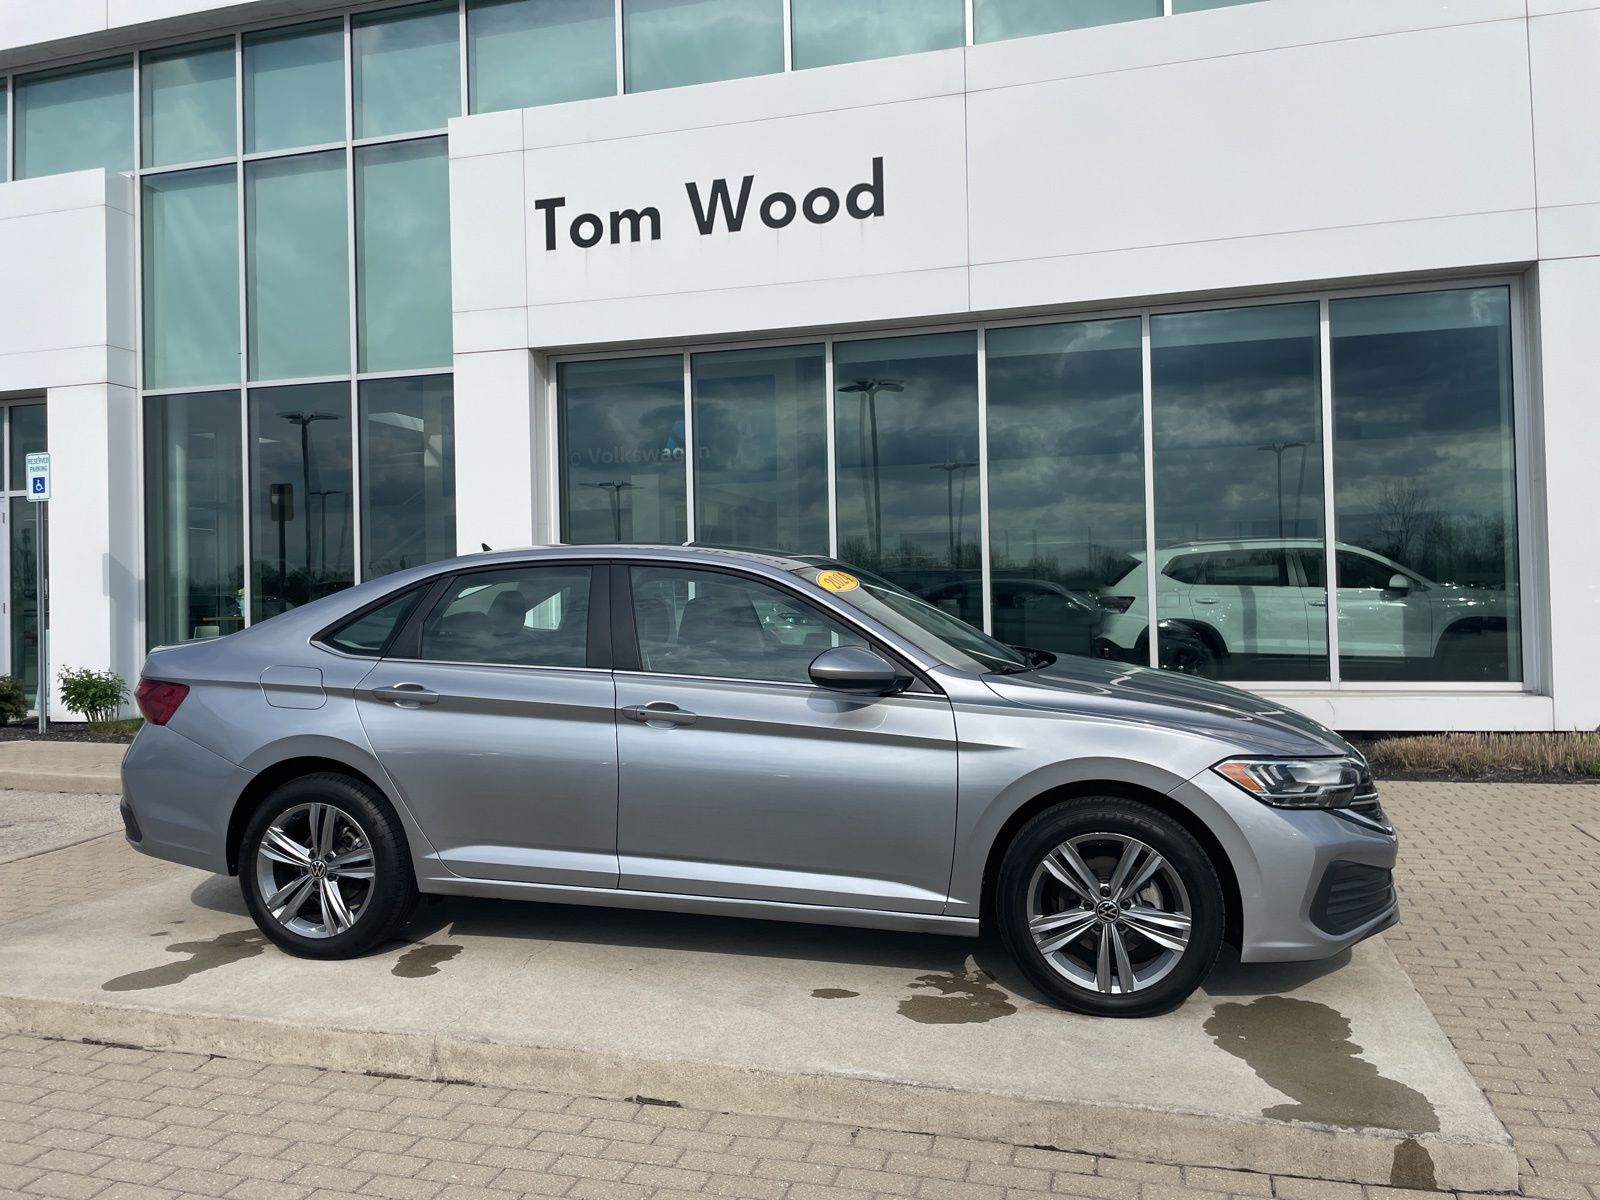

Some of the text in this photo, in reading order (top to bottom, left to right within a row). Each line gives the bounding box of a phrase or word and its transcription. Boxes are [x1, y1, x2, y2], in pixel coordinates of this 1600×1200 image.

[534, 156, 885, 251] Tom Wood
[587, 445, 711, 465] Volkswagn
[823, 571, 855, 590] 2024
